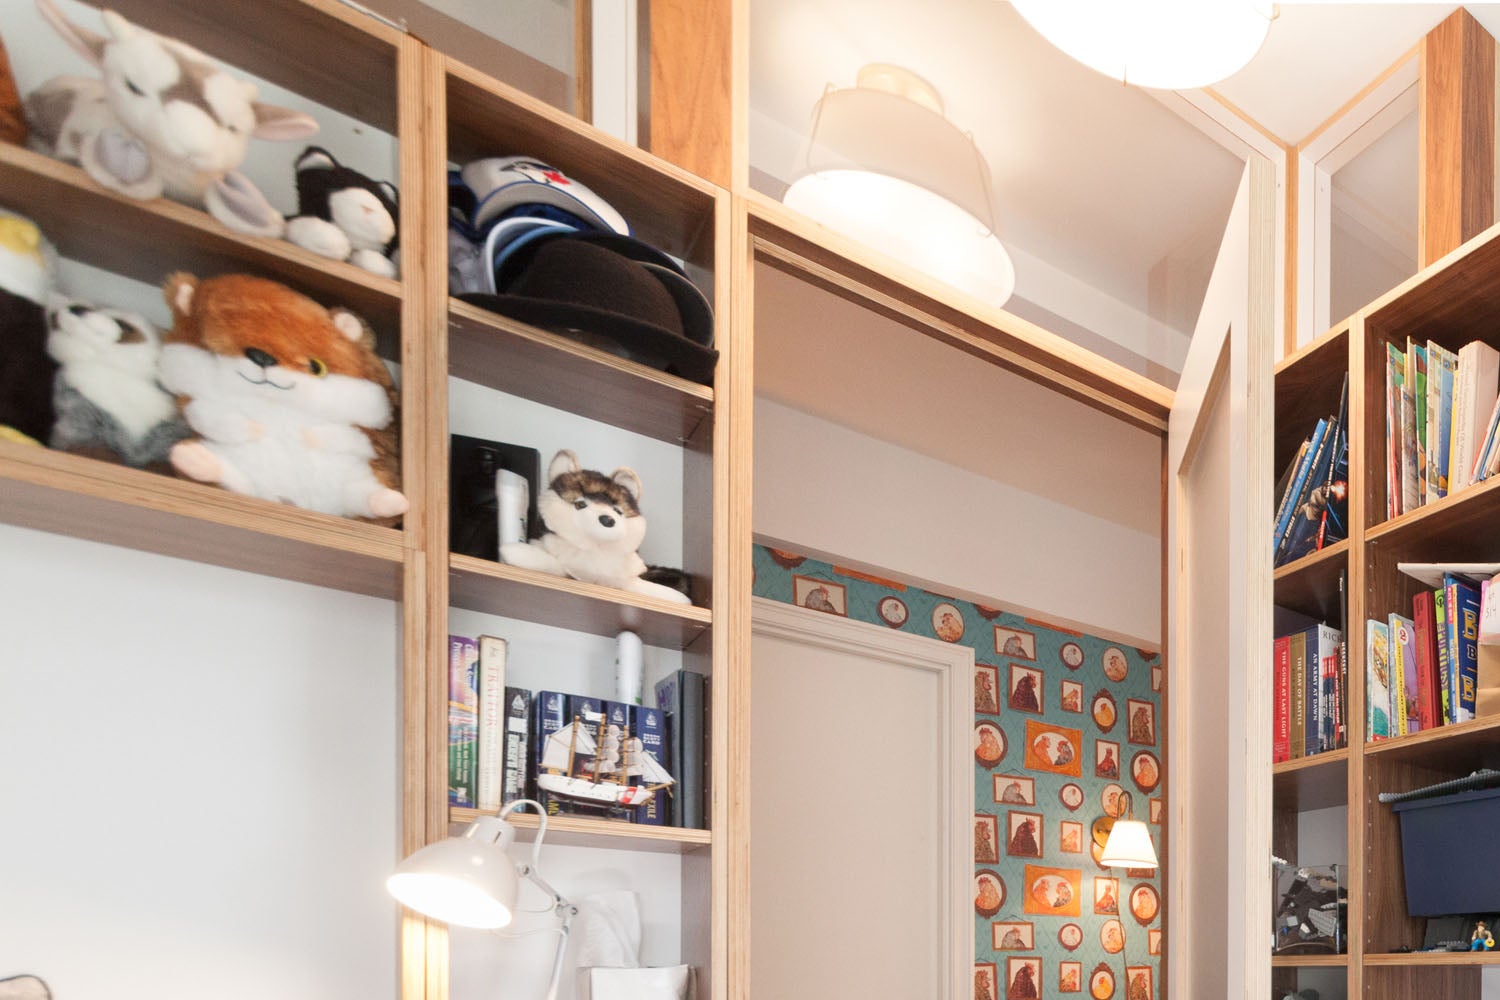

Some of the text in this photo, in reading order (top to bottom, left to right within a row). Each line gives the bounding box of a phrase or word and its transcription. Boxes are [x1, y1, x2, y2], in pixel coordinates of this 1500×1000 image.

[1312, 653, 1318, 664] AN
[486, 665, 498, 728] TRAITOR
[1281, 689, 1286, 697] AT
[1297, 689, 1302, 697] OF
[1312, 688, 1318, 696] AT
[506, 769, 518, 793] GAME
